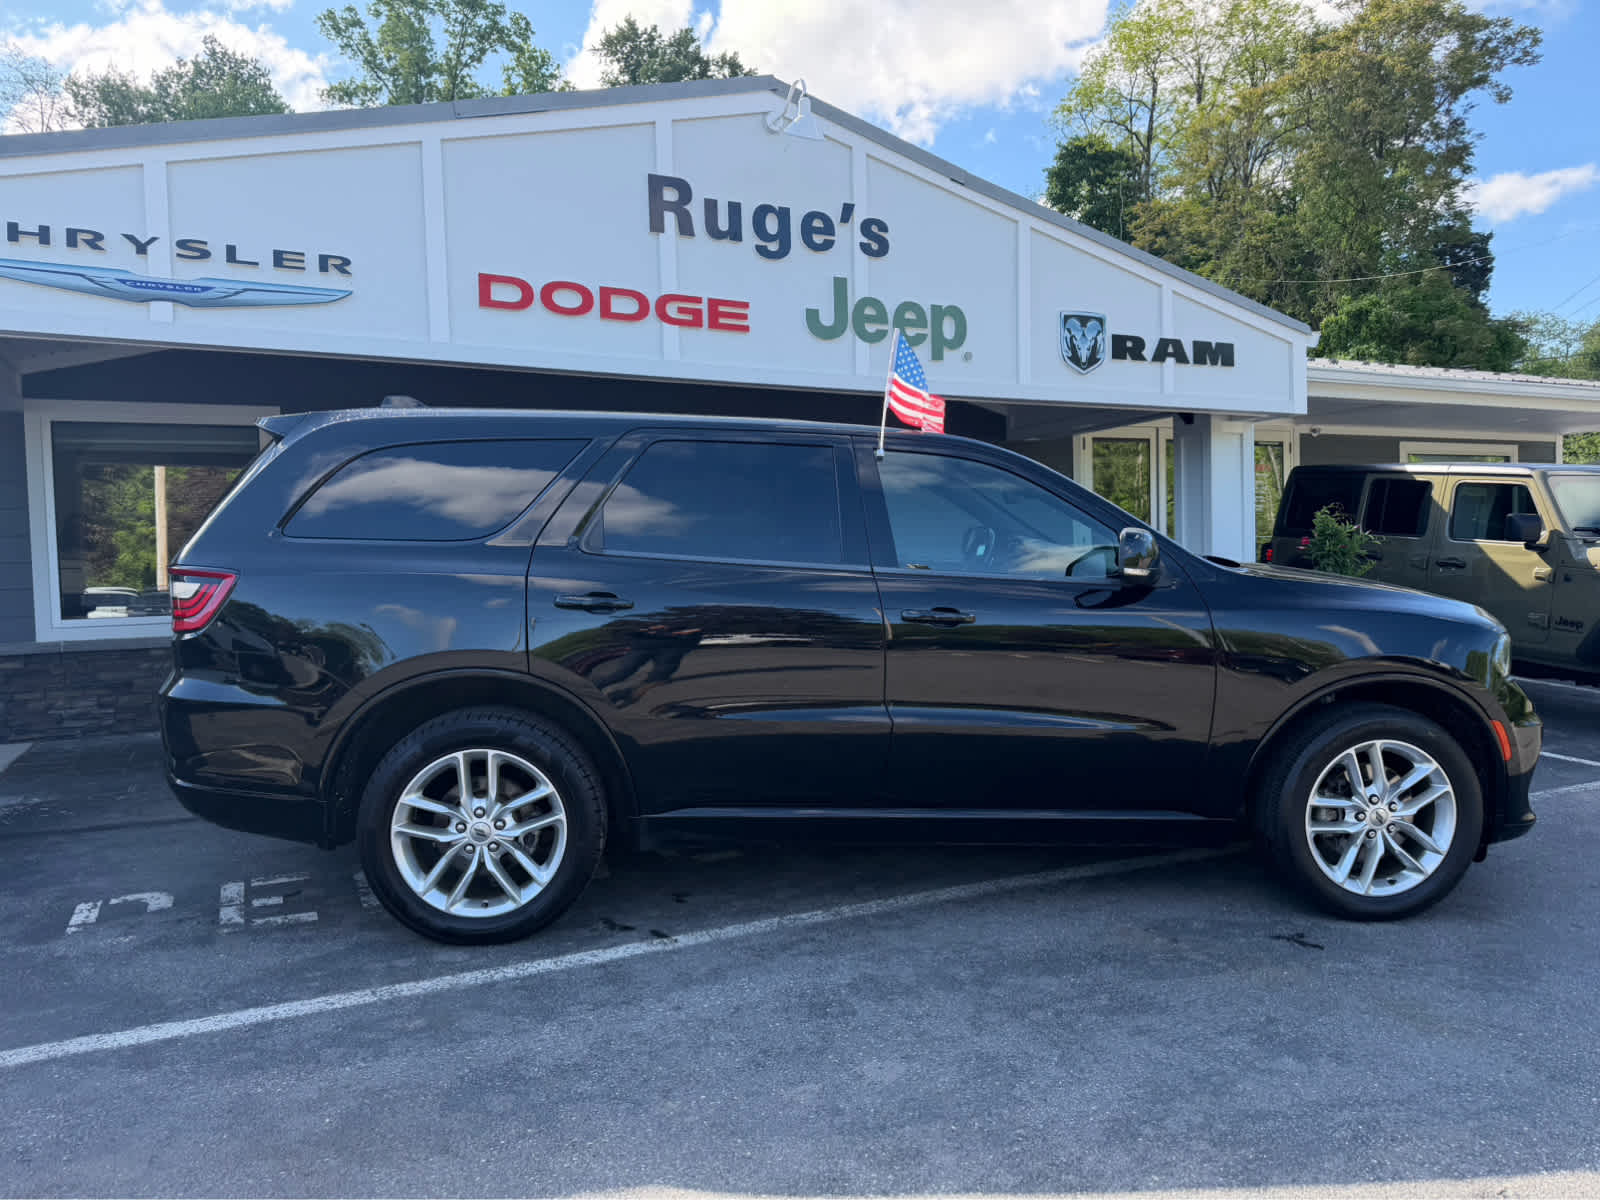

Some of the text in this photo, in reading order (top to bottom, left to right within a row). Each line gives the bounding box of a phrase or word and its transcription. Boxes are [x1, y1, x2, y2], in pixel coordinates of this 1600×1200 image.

[647, 173, 890, 260] Ruge's
[6, 221, 352, 275] HRYSLER
[478, 272, 750, 332] DODGE
[805, 276, 967, 360] Jeep
[1111, 333, 1234, 367] RAM
